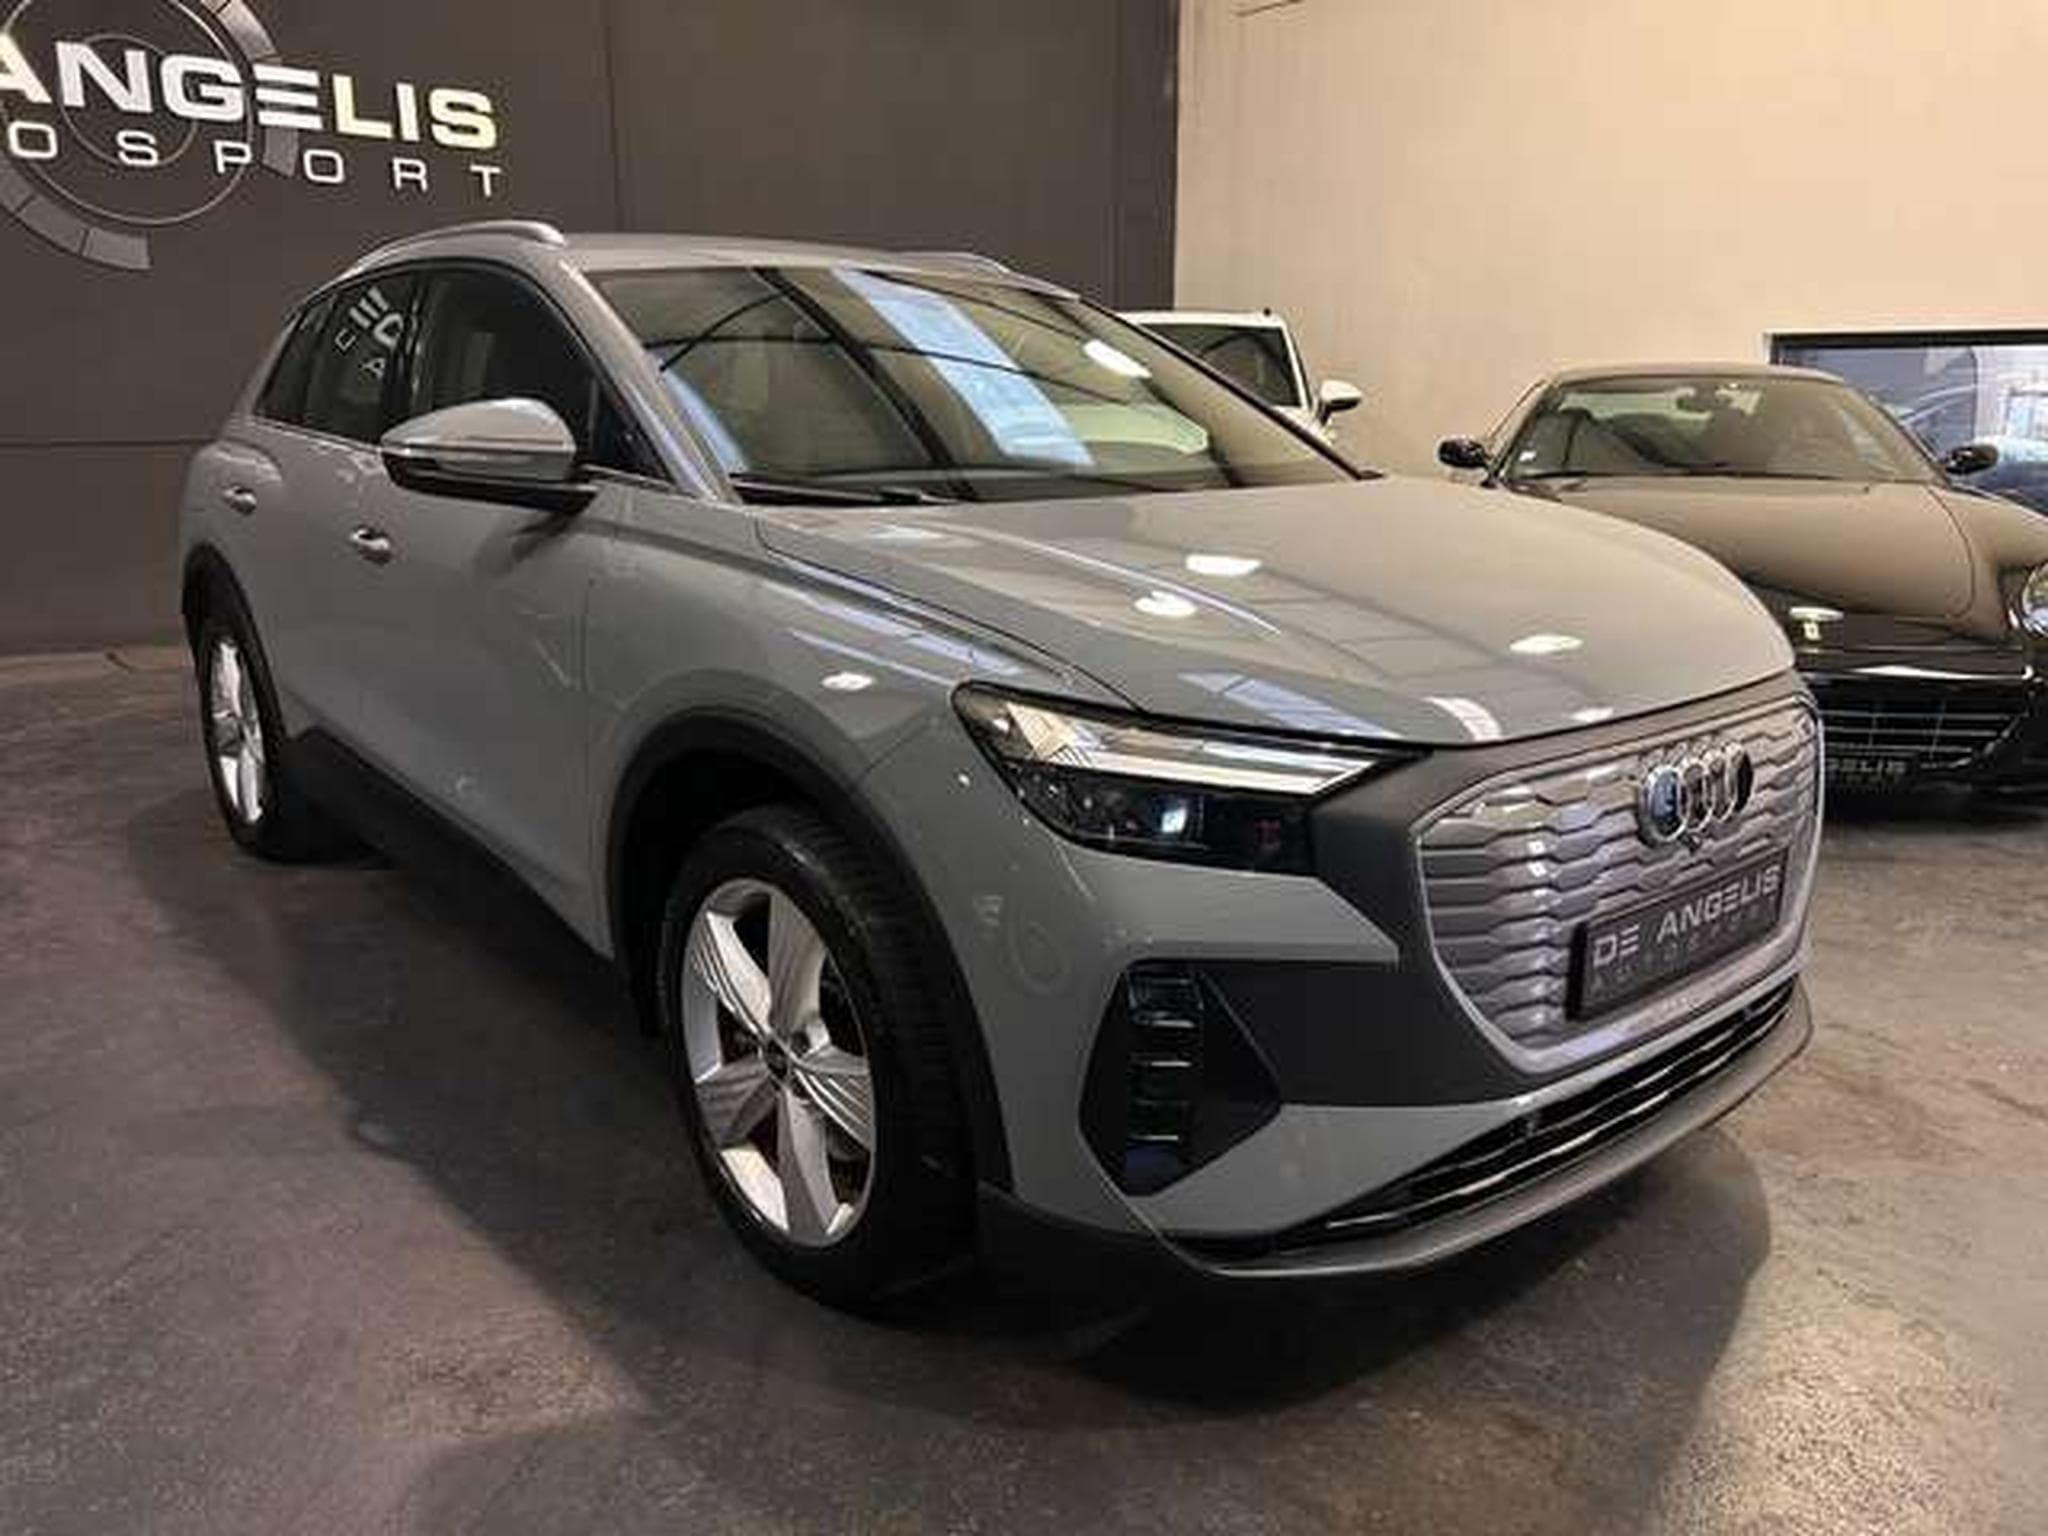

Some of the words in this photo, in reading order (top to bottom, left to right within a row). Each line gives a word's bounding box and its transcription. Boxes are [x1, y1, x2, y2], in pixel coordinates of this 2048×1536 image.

[0, 33, 498, 149] ANGELIS
[1593, 923, 1641, 967] DE
[1656, 865, 1781, 944] ANGELIS
